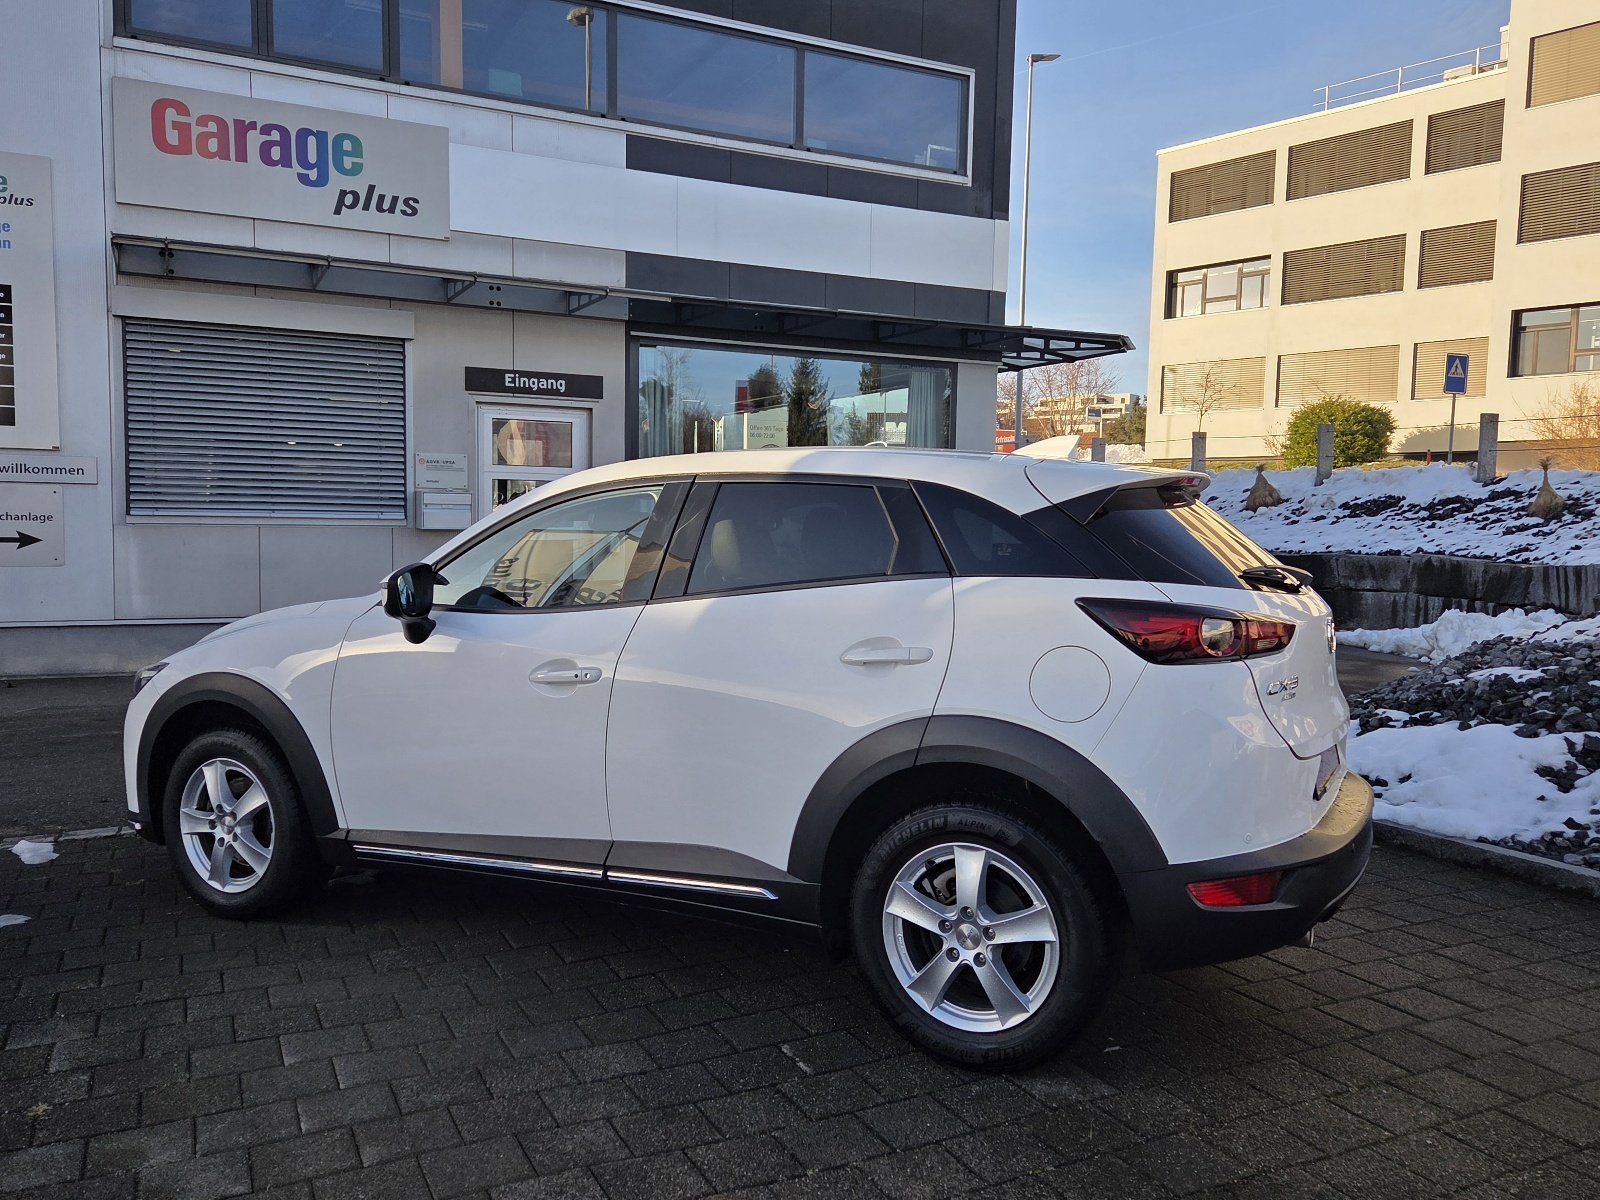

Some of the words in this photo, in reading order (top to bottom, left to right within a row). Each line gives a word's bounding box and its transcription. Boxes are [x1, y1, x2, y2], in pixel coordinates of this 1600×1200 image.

[150, 97, 364, 188] Garage
[333, 184, 420, 217] plus
[504, 373, 566, 392] Eingang
[878, 815, 946, 860] MICHELIN
